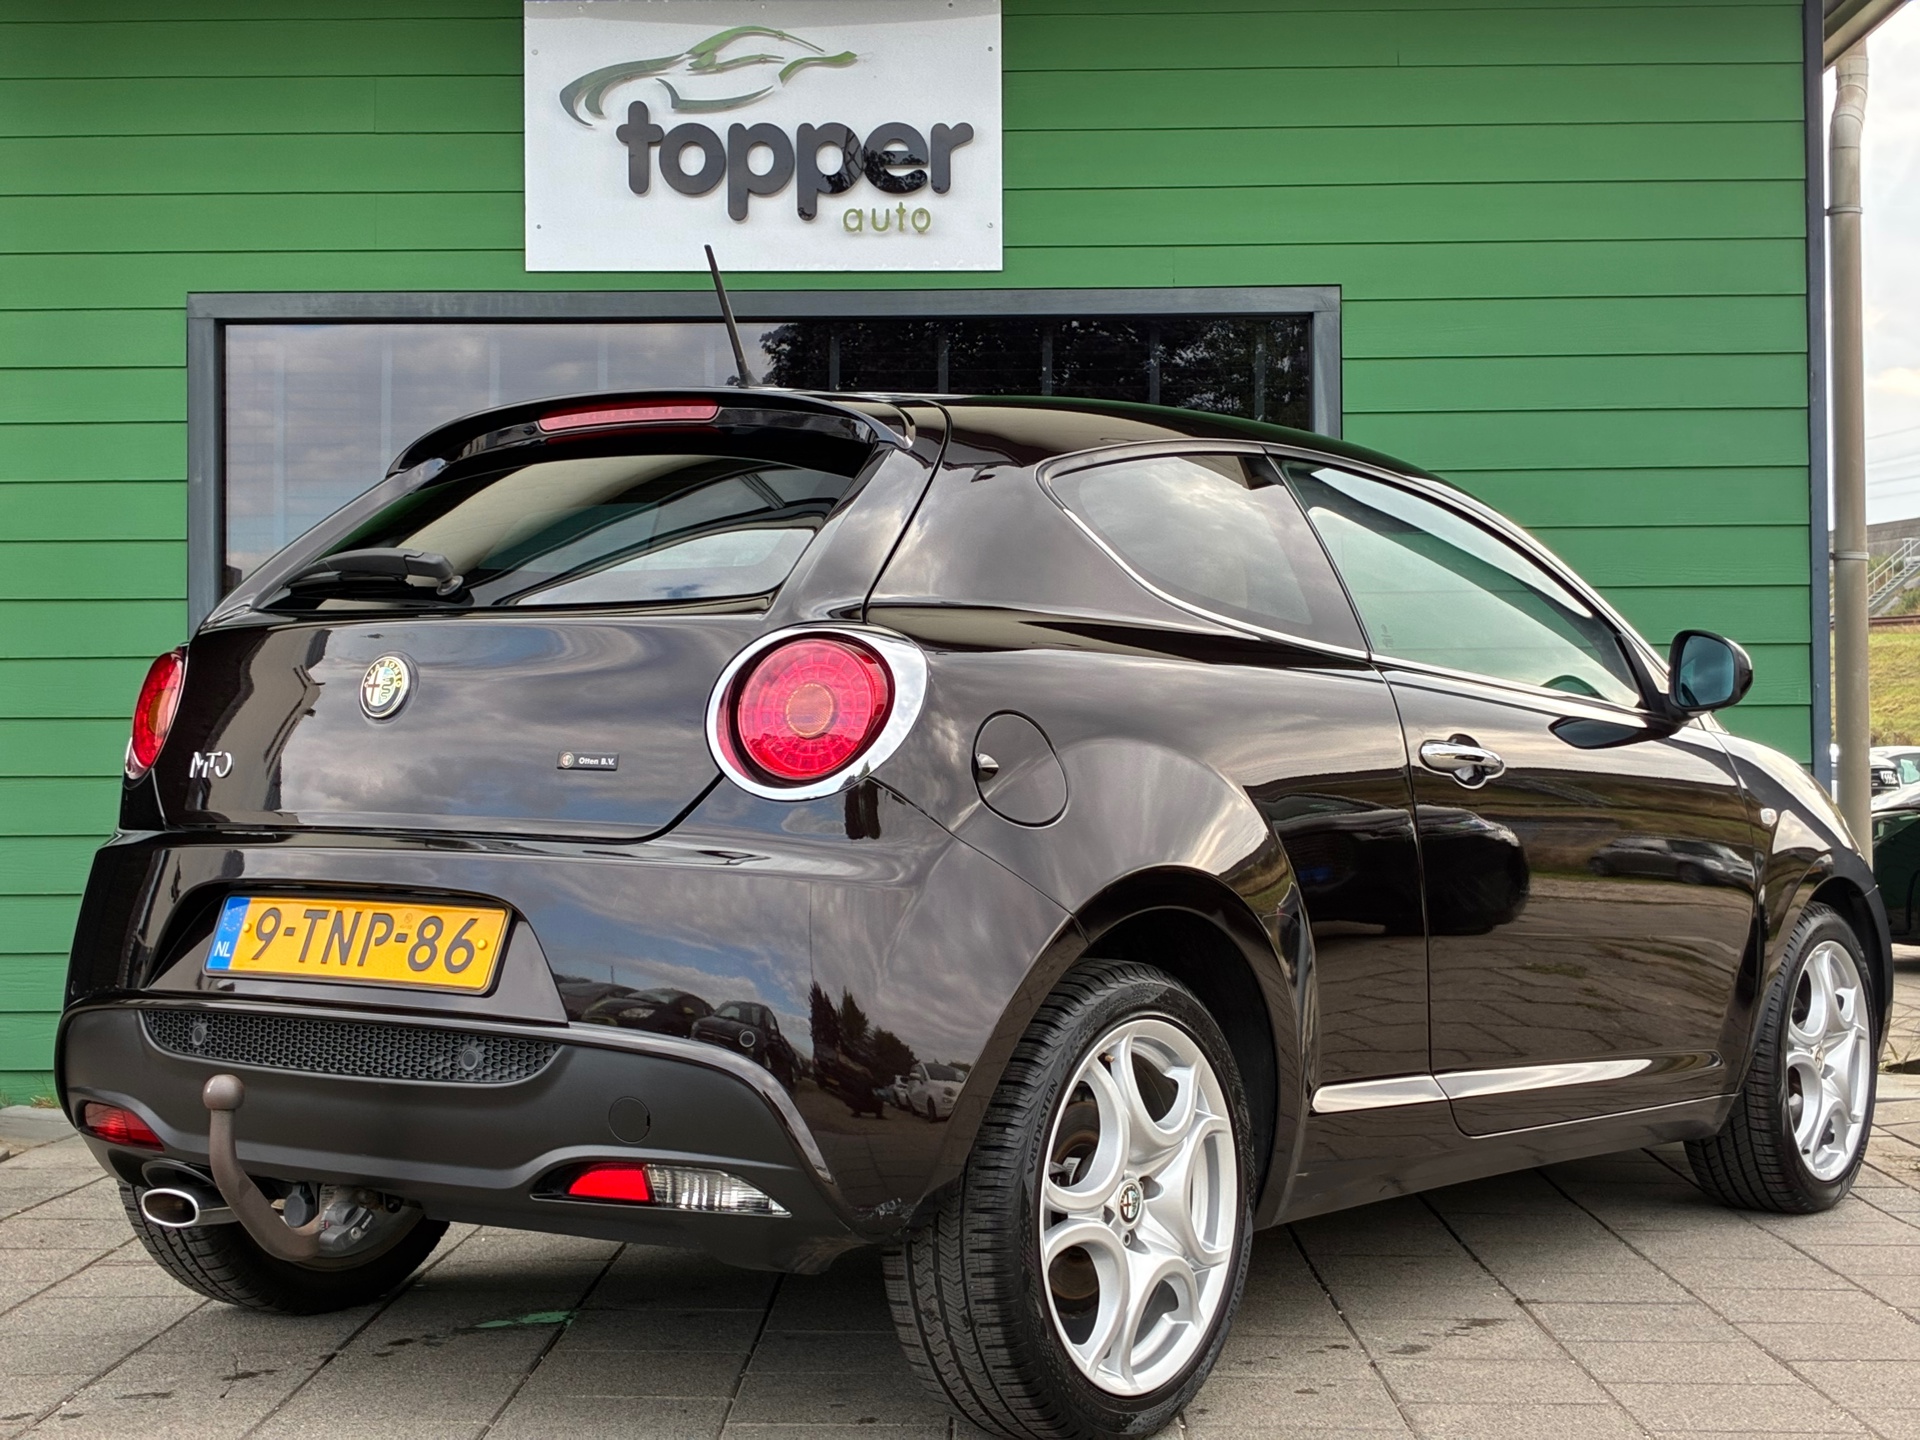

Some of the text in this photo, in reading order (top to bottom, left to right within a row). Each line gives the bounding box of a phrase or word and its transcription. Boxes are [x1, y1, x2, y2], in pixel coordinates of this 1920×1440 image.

[616, 101, 974, 220] topper
[843, 202, 931, 232] auto
[214, 941, 231, 957] NL
[251, 907, 478, 973] 9-TNP-86
[1027, 1078, 1059, 1174] VREDESTEIN
